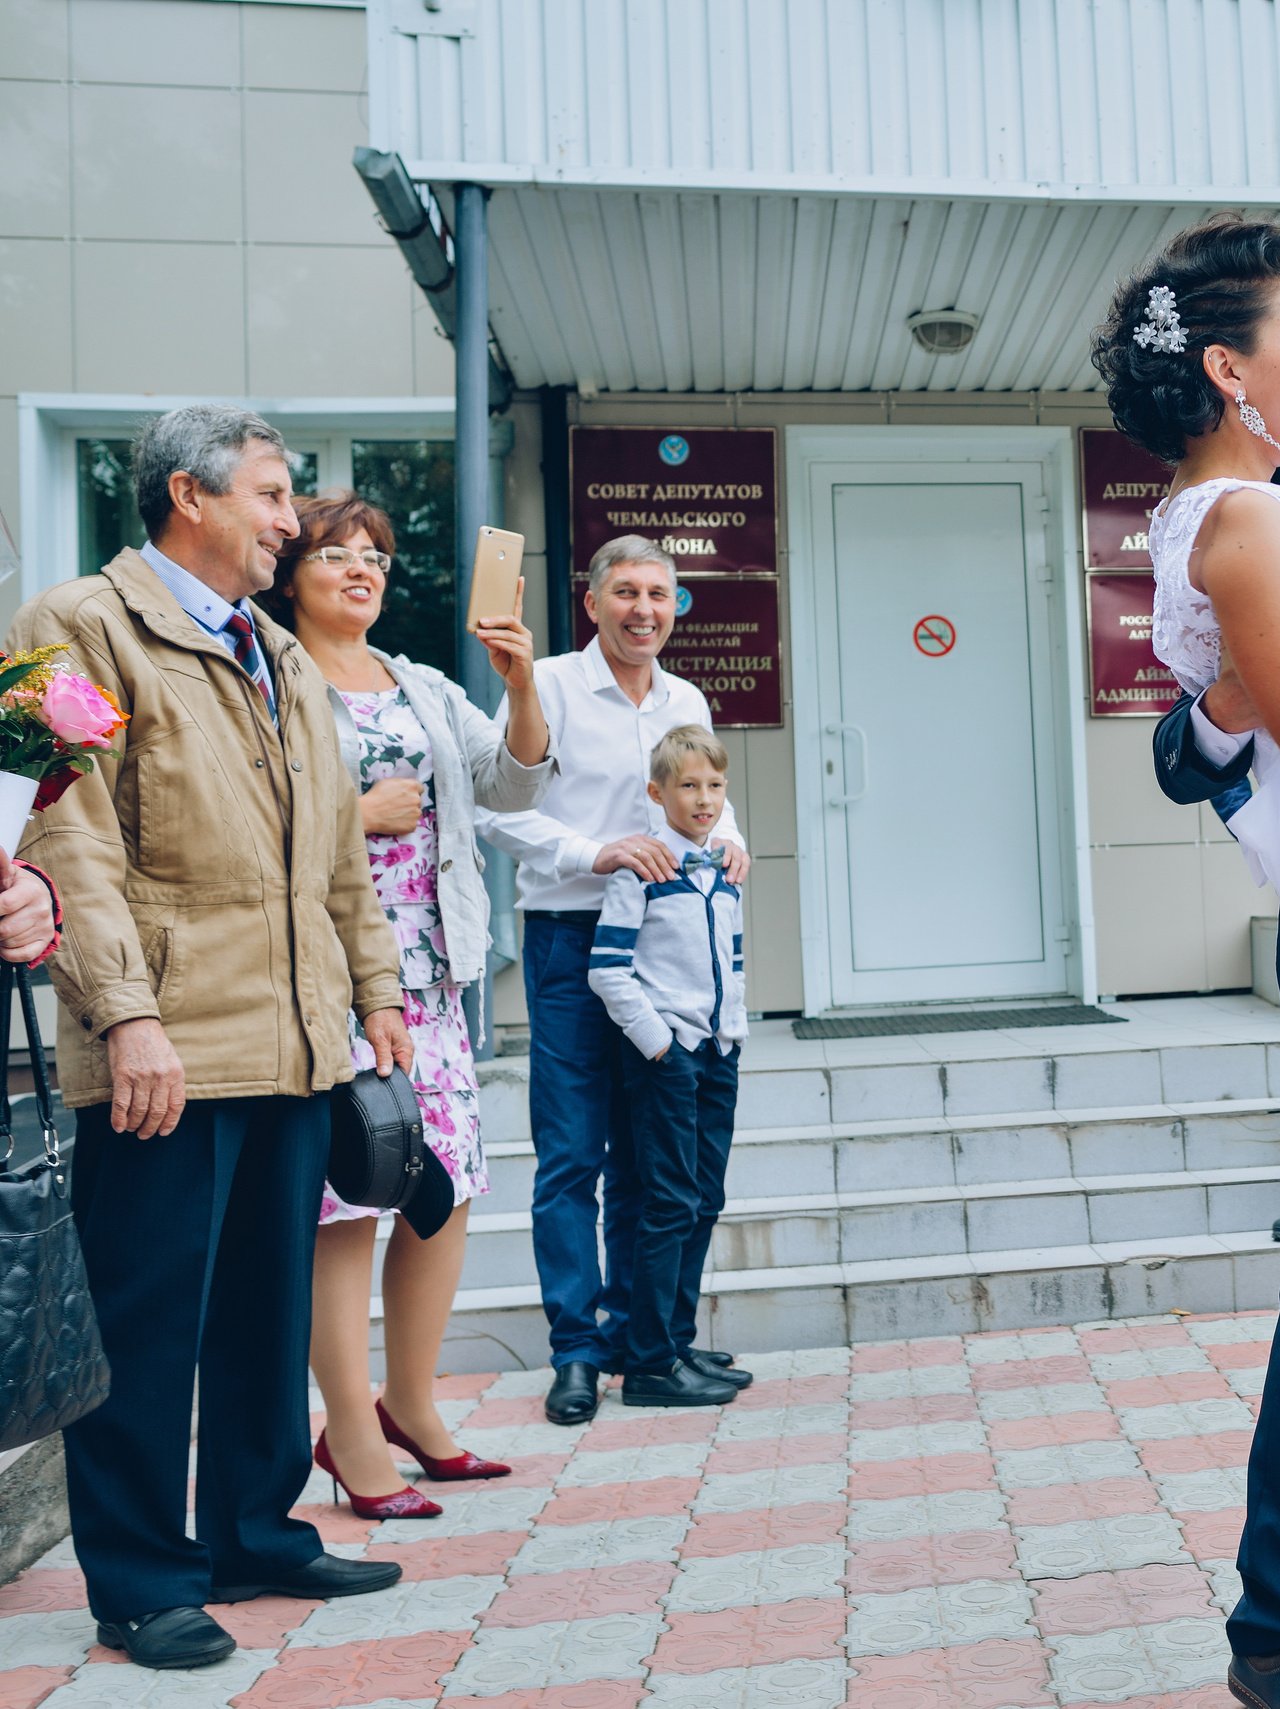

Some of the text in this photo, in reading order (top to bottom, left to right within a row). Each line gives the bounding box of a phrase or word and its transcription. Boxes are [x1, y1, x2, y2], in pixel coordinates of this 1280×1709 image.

[587, 483, 763, 502] СОВЕТ ДЕПУТАТОВ
[1102, 483, 1171, 500] ДЕПУТА
[606, 511, 746, 527] ЧЕМАЛЬСКОГО
[656, 535, 717, 555] ЙОНА
[1120, 532, 1149, 551] АЙ
[685, 622, 759, 634] ФЕДЕРАЦИЯ
[1119, 615, 1153, 627] РОСС
[701, 635, 741, 647] АЛТАЙ
[1128, 629, 1152, 641] АЛТ
[661, 656, 773, 675] ИСТРАЦИЯ
[1134, 666, 1176, 682] АЙМ
[1096, 688, 1180, 704] АДМИНИС
